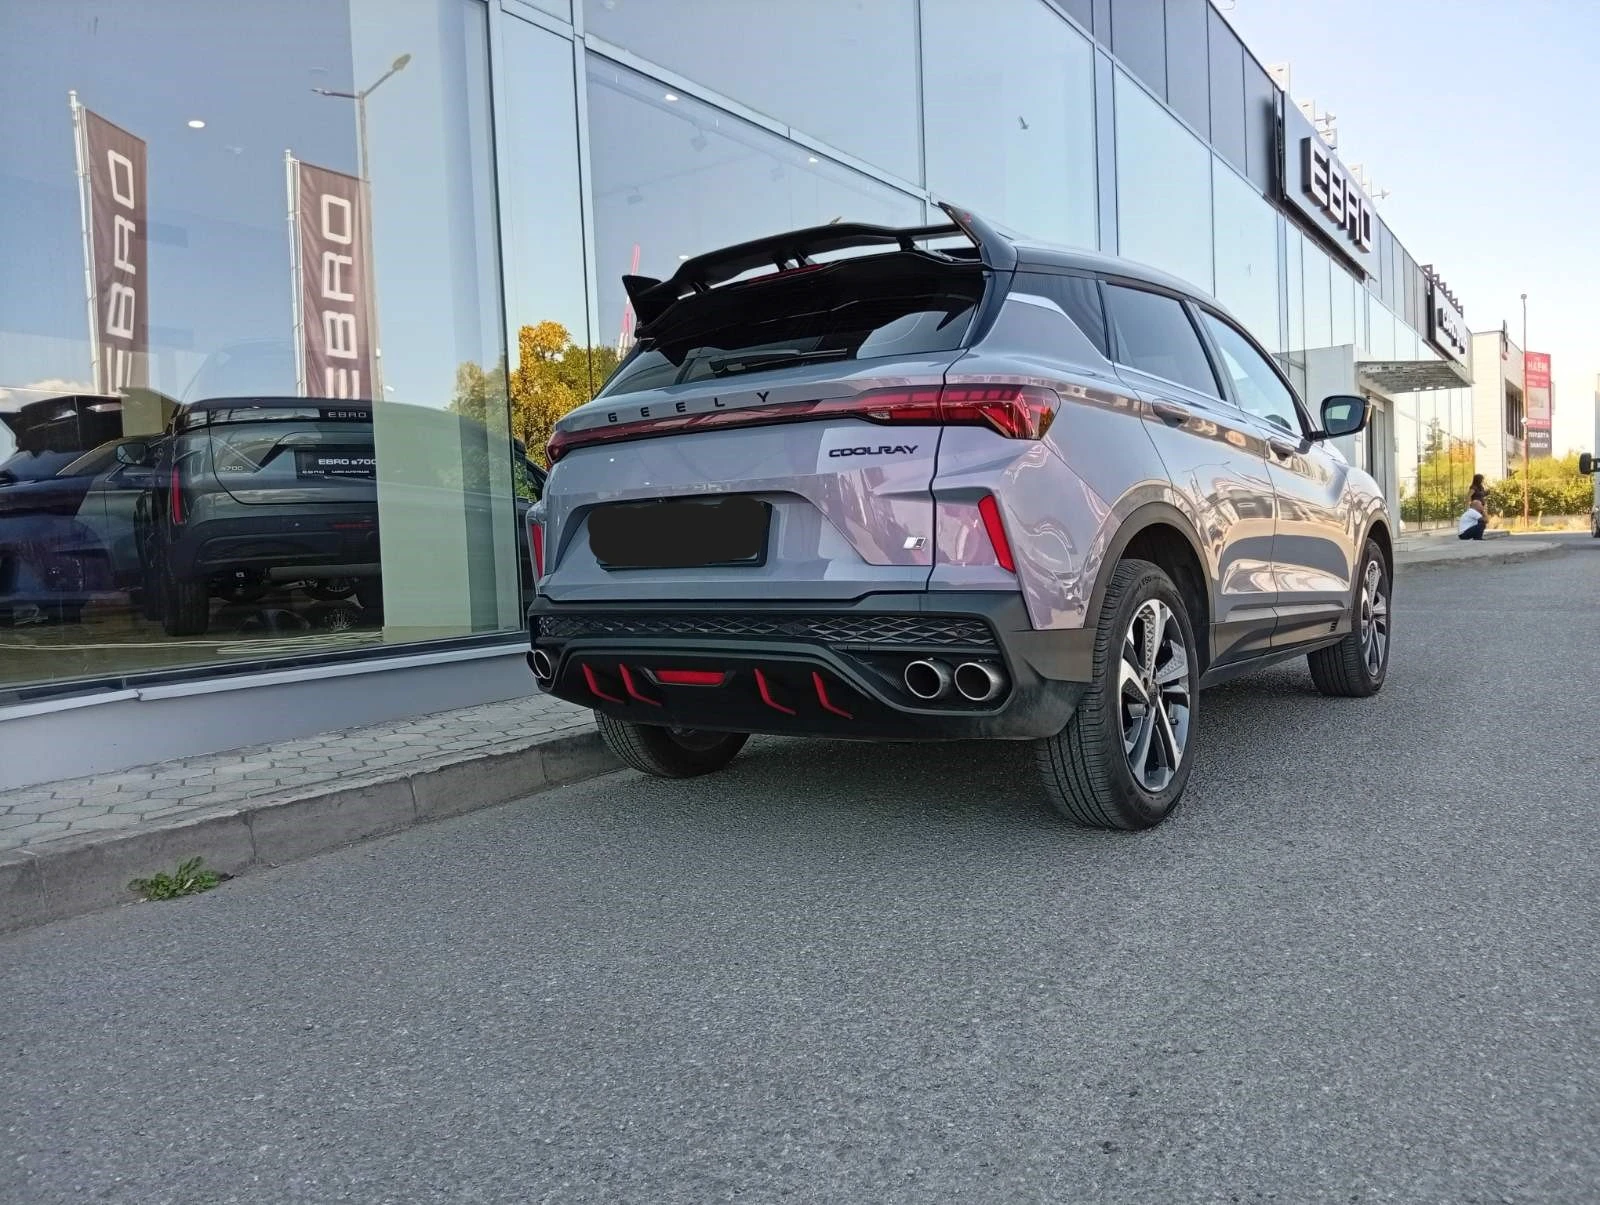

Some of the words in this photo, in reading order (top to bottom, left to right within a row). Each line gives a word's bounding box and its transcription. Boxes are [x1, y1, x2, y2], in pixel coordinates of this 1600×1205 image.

[1301, 137, 1372, 253] EBRO
[105, 149, 137, 396] EBRO
[320, 193, 361, 400] EBRO
[607, 391, 770, 423] GEELY
[828, 444, 919, 458] COOLRAY
